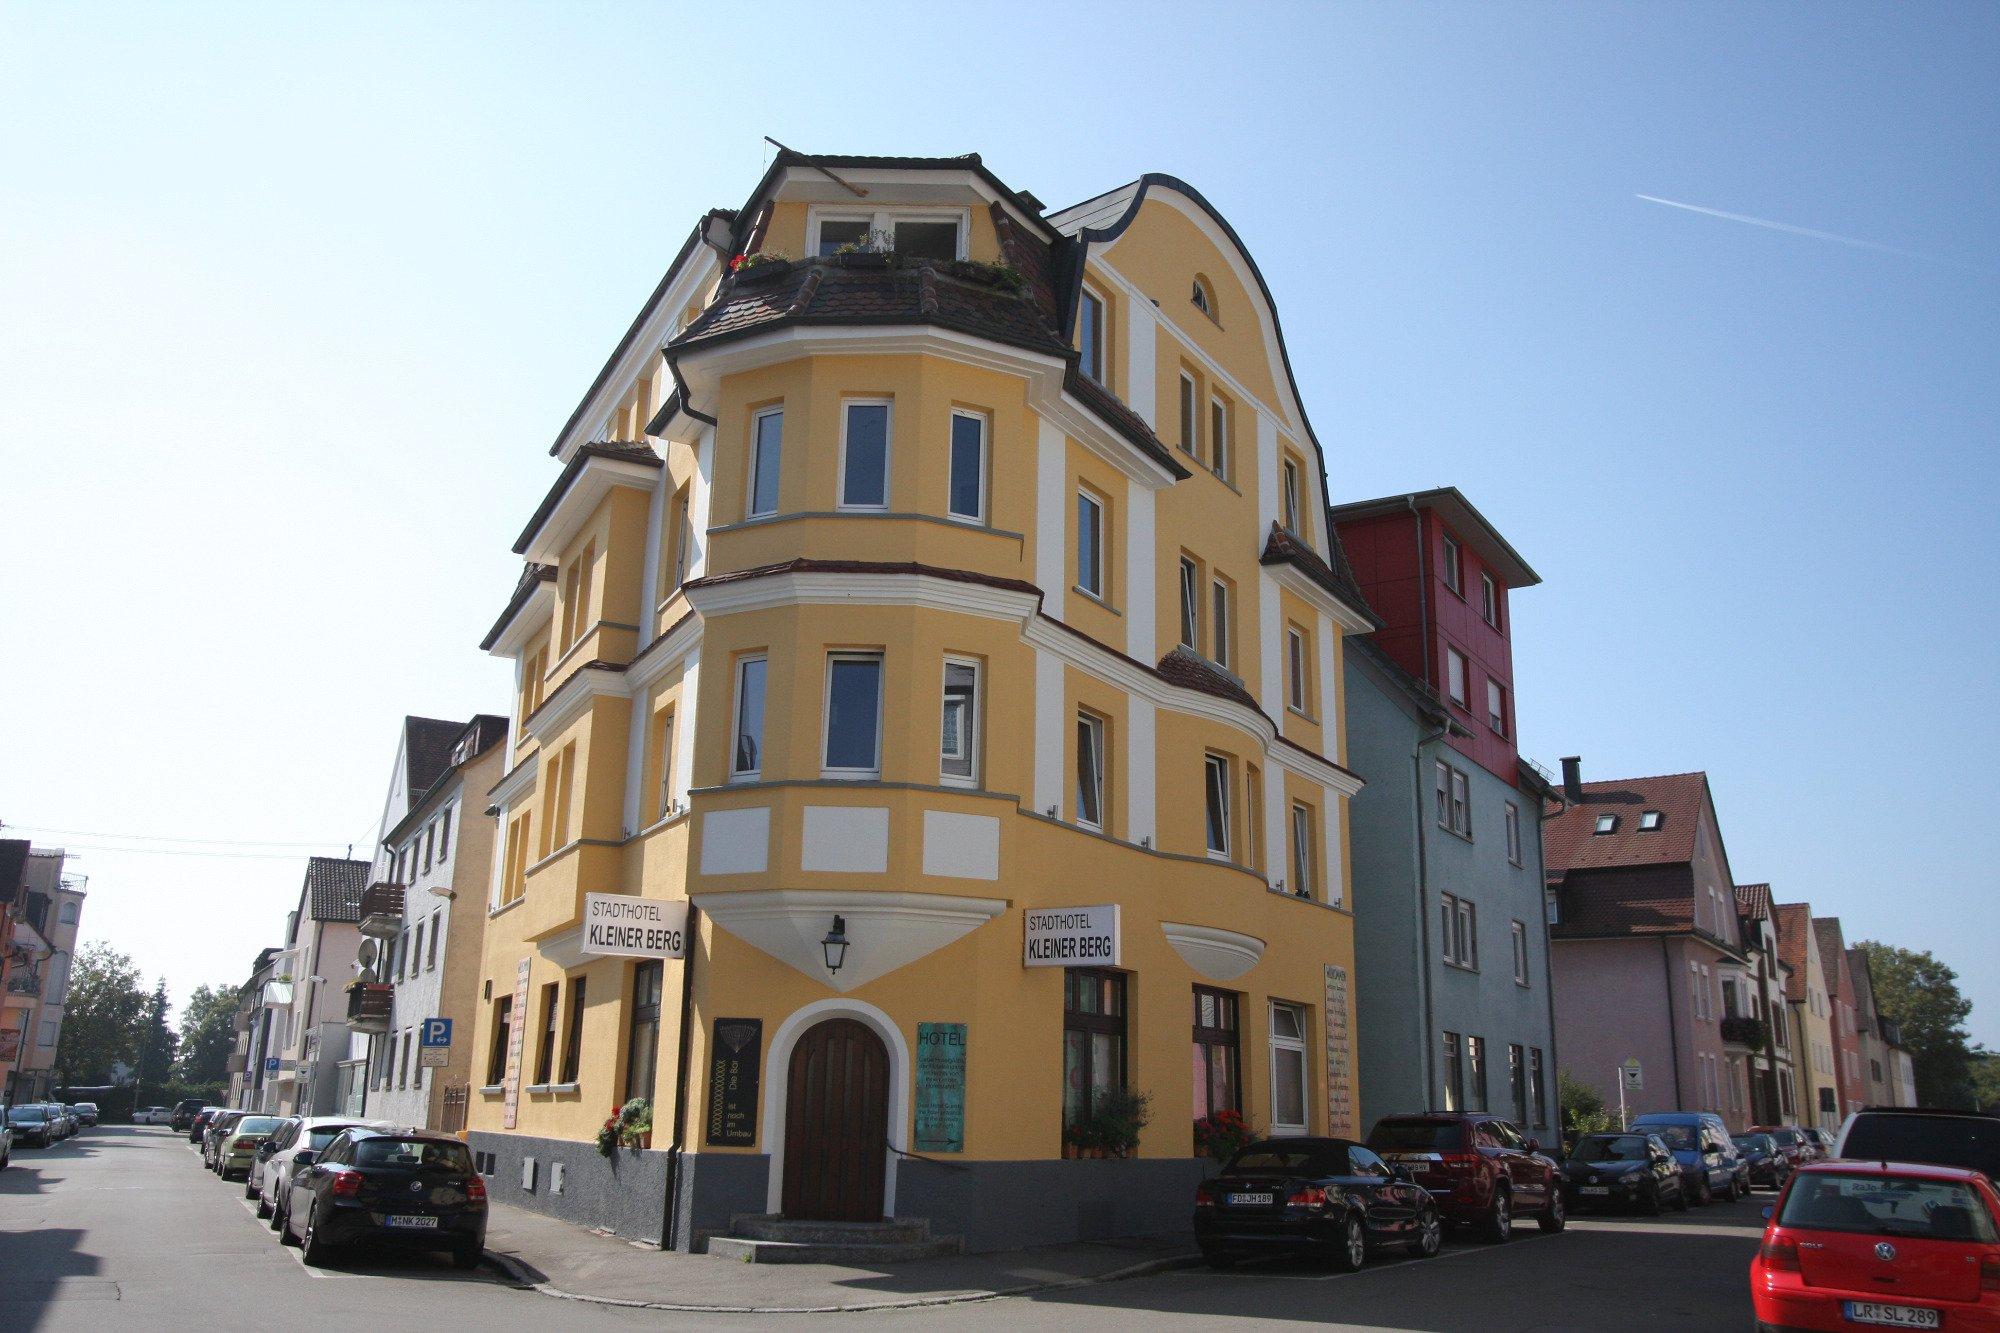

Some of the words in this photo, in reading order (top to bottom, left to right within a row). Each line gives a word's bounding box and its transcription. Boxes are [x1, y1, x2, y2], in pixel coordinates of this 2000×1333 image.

[592, 901, 662, 922] STADTHOTEL
[1029, 913, 1092, 931] STADTHOTEL
[590, 924, 643, 949] KLEINER
[646, 928, 681, 952] BERG
[1029, 937, 1077, 959] KLEINER
[1079, 935, 1111, 958] BERG
[429, 1021, 446, 1043] P
[918, 1032, 966, 1046] HOTEL
[269, 1059, 277, 1069] P
[730, 1060, 739, 1075] Bar
[729, 1076, 738, 1090] Die
[728, 1102, 737, 1110] ist
[726, 1129, 752, 1138] Umbau
[401, 1216, 415, 1225] NK
[415, 1217, 436, 1227] 2027
[1853, 1303, 1874, 1319] LR
[1883, 1306, 1904, 1322] SL
[1906, 1308, 1937, 1325] 289
